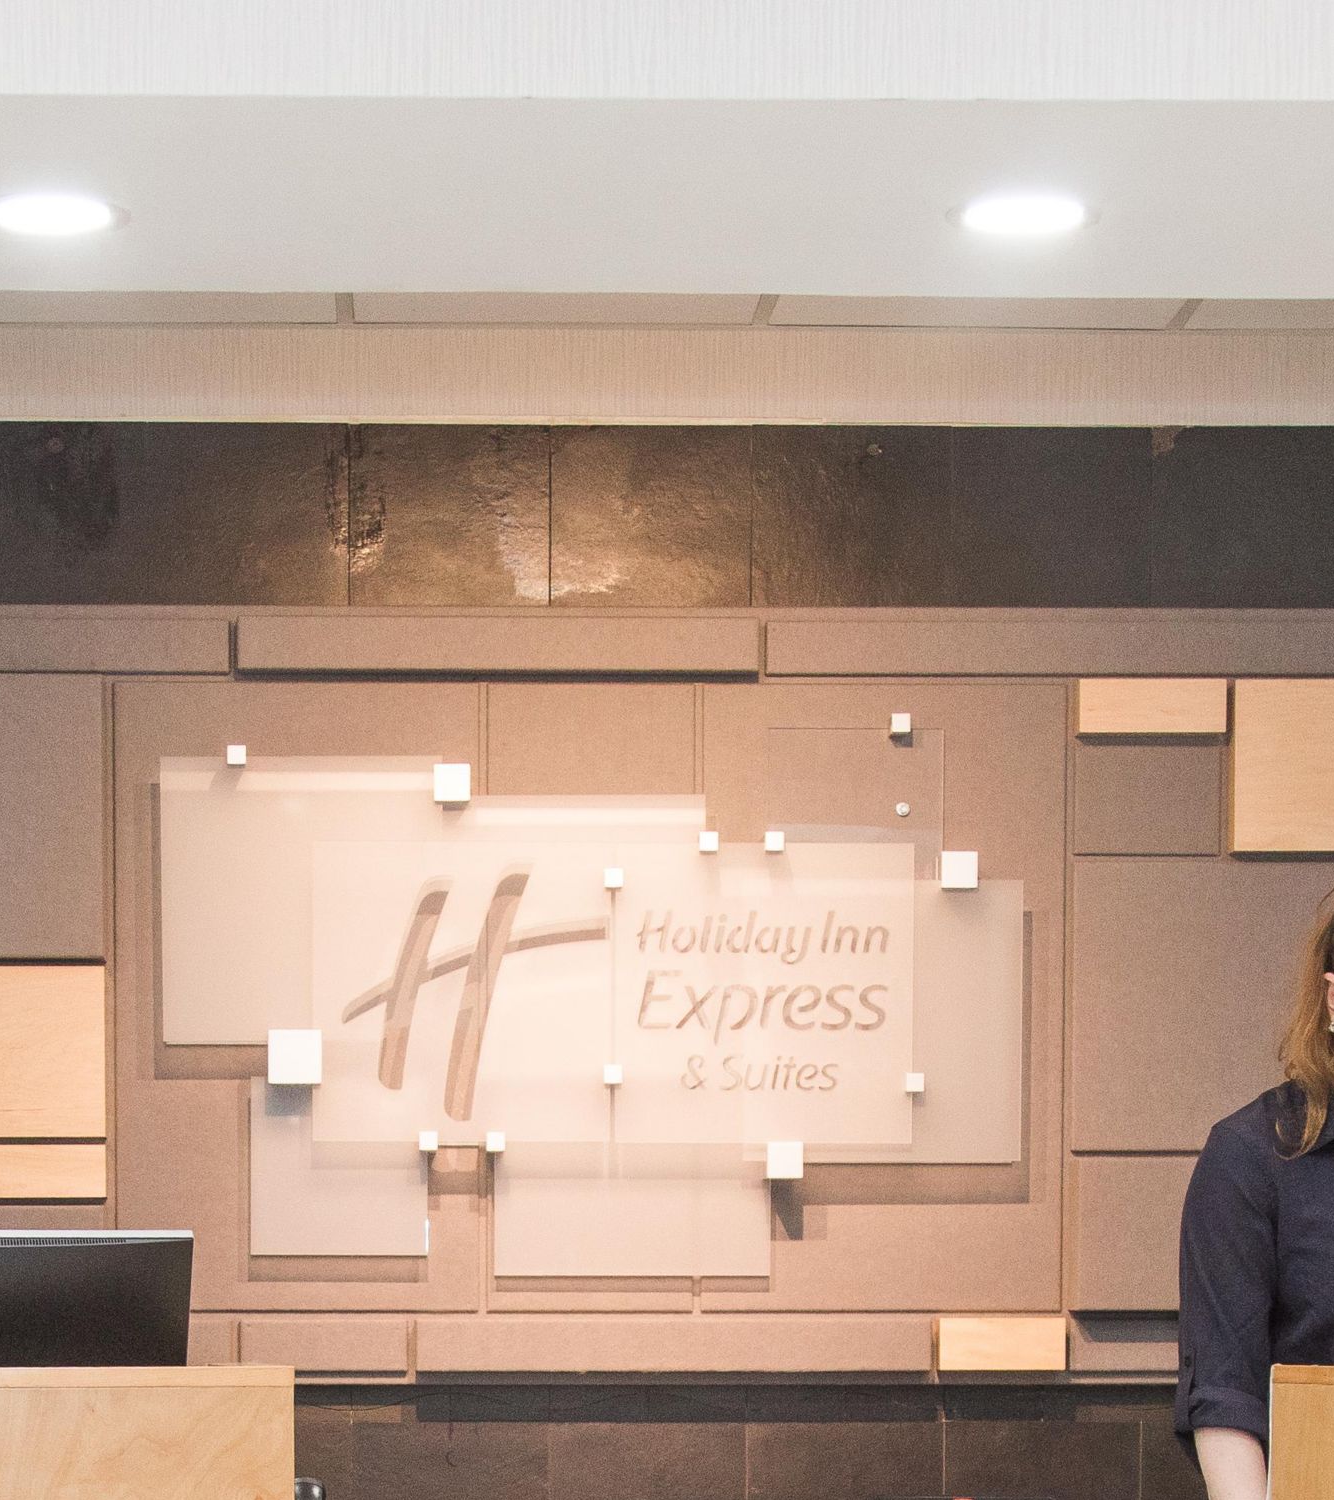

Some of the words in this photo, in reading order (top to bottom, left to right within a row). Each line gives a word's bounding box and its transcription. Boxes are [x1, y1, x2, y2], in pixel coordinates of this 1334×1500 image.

[636, 910, 812, 965] Holiday
[820, 910, 890, 954] Inn
[637, 969, 889, 1046] Express
[680, 1054, 706, 1091] &
[719, 1055, 839, 1092] Suites
